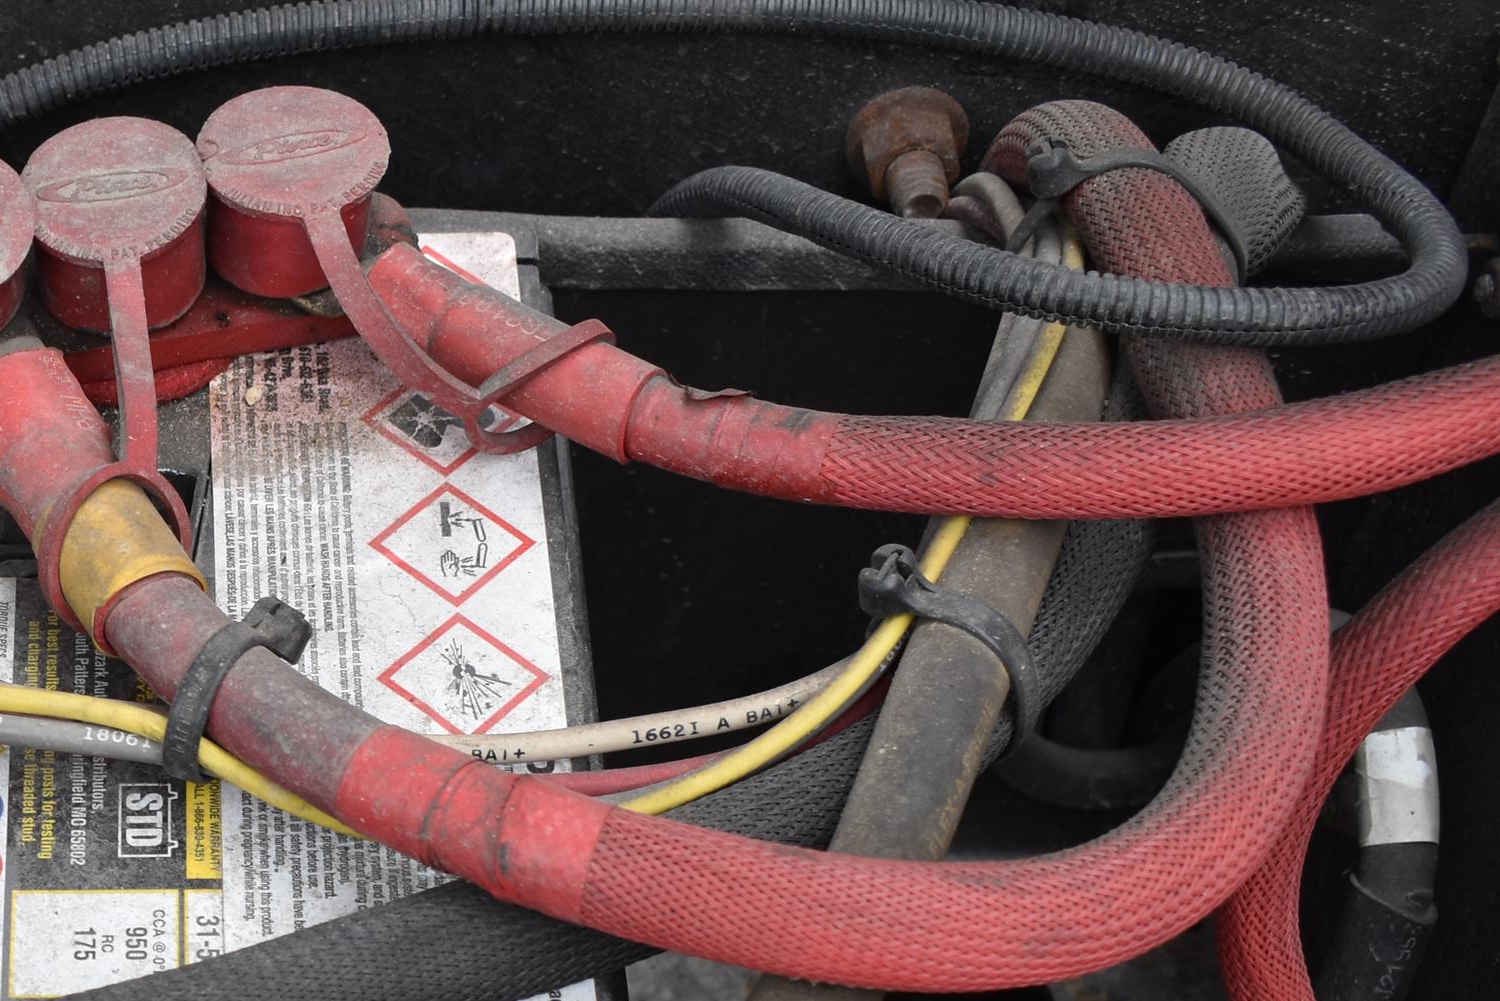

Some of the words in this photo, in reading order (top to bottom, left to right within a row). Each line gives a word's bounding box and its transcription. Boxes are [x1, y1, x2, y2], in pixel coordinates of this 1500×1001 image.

[27, 621, 40, 639] and
[46, 629, 58, 652] best
[717, 716, 731, 732] A
[22, 764, 36, 813] threaded
[41, 767, 55, 796] posts
[42, 800, 55, 815] for
[71, 807, 86, 825] MO
[126, 793, 163, 846] STD
[240, 807, 253, 828] during
[20, 817, 35, 845] stud.
[257, 823, 269, 847] smoke
[274, 816, 284, 831] after
[37, 819, 54, 858] testing
[70, 830, 85, 864] 65802
[210, 822, 221, 871] WARRANTY
[273, 834, 286, 867] handling.
[289, 833, 302, 855] safety
[240, 831, 255, 889] pregnancy/while
[259, 849, 270, 868] when
[307, 850, 318, 871] before
[320, 835, 333, 870] projection
[257, 870, 271, 890] using
[289, 858, 303, 898] precautions
[307, 873, 316, 888] use.
[324, 873, 335, 898] hazard.
[243, 891, 256, 921] nursing.
[261, 892, 272, 905] this
[293, 900, 304, 918] have
[152, 910, 166, 937] CCA
[259, 907, 273, 936] product.
[74, 927, 96, 960] 175
[101, 935, 114, 952] RC
[125, 927, 148, 960] 950
[196, 916, 220, 962] 31-5
